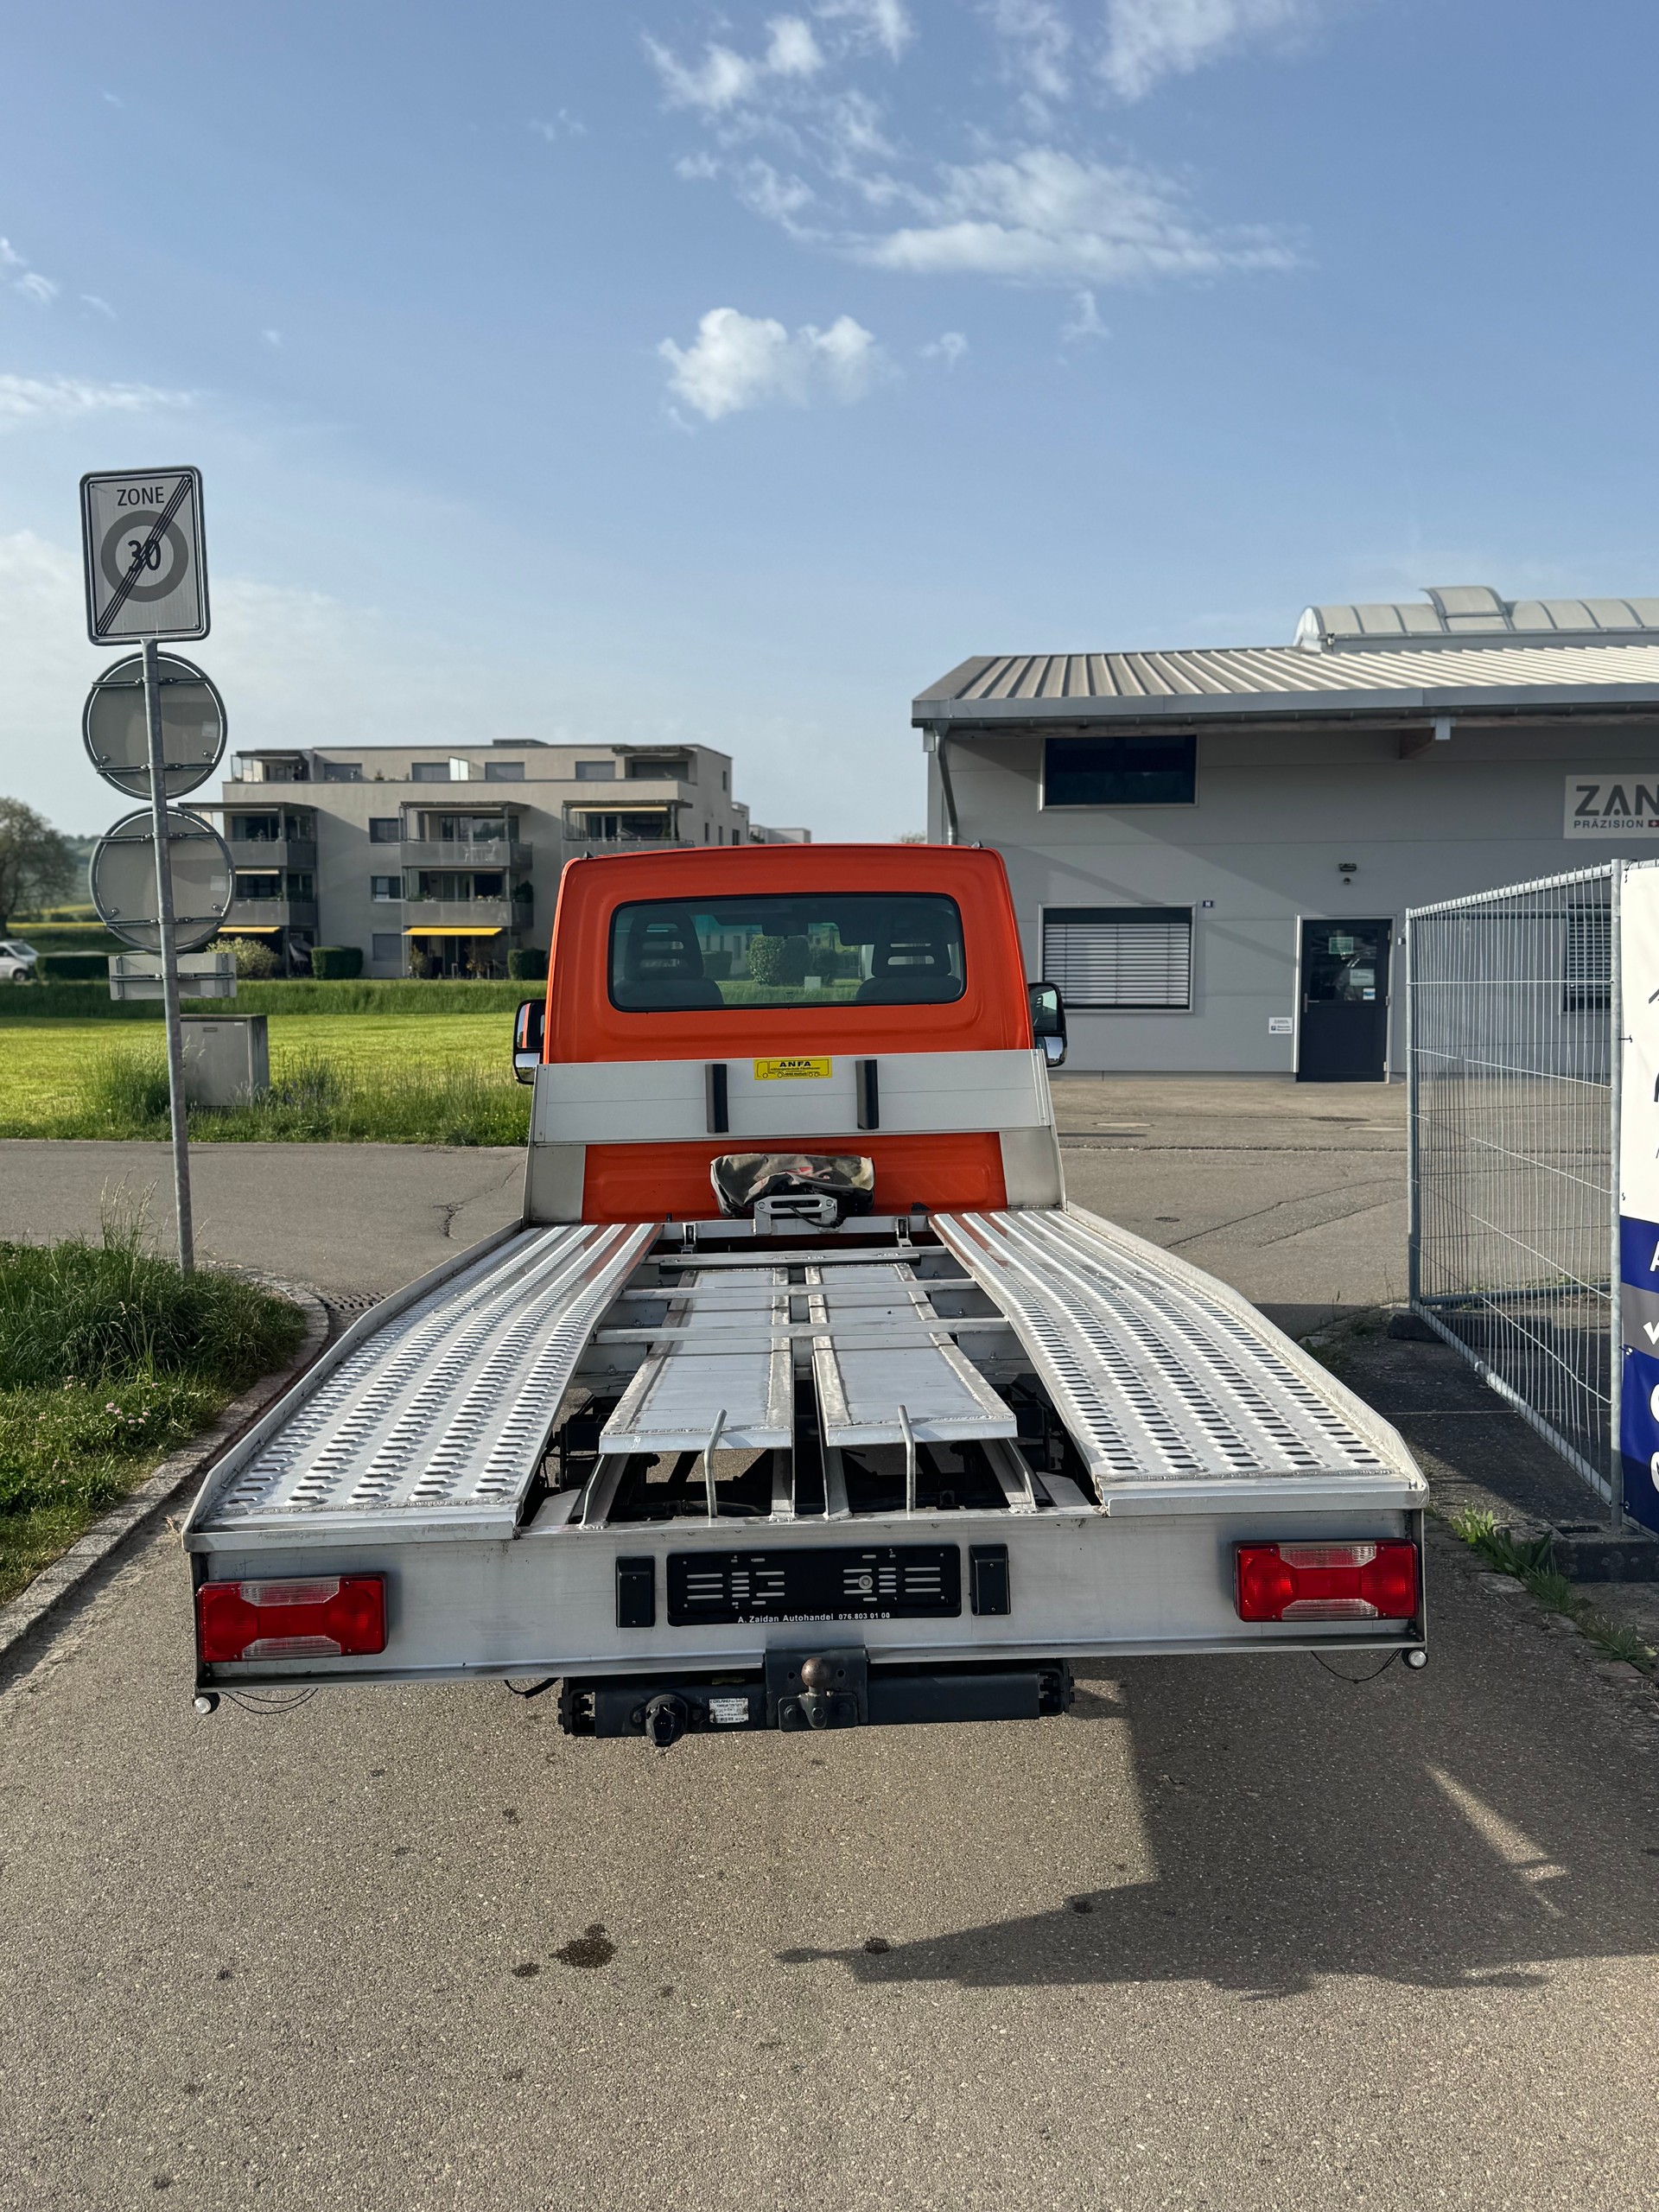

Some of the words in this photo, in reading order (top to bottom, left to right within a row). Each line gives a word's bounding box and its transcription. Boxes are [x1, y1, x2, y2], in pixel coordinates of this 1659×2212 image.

[117, 486, 165, 506] ZONE
[128, 538, 162, 573] 30
[1573, 818, 1643, 829] PRÄZISION
[748, 1615, 779, 1624] Zaidan
[782, 1613, 834, 1623] Autohandel
